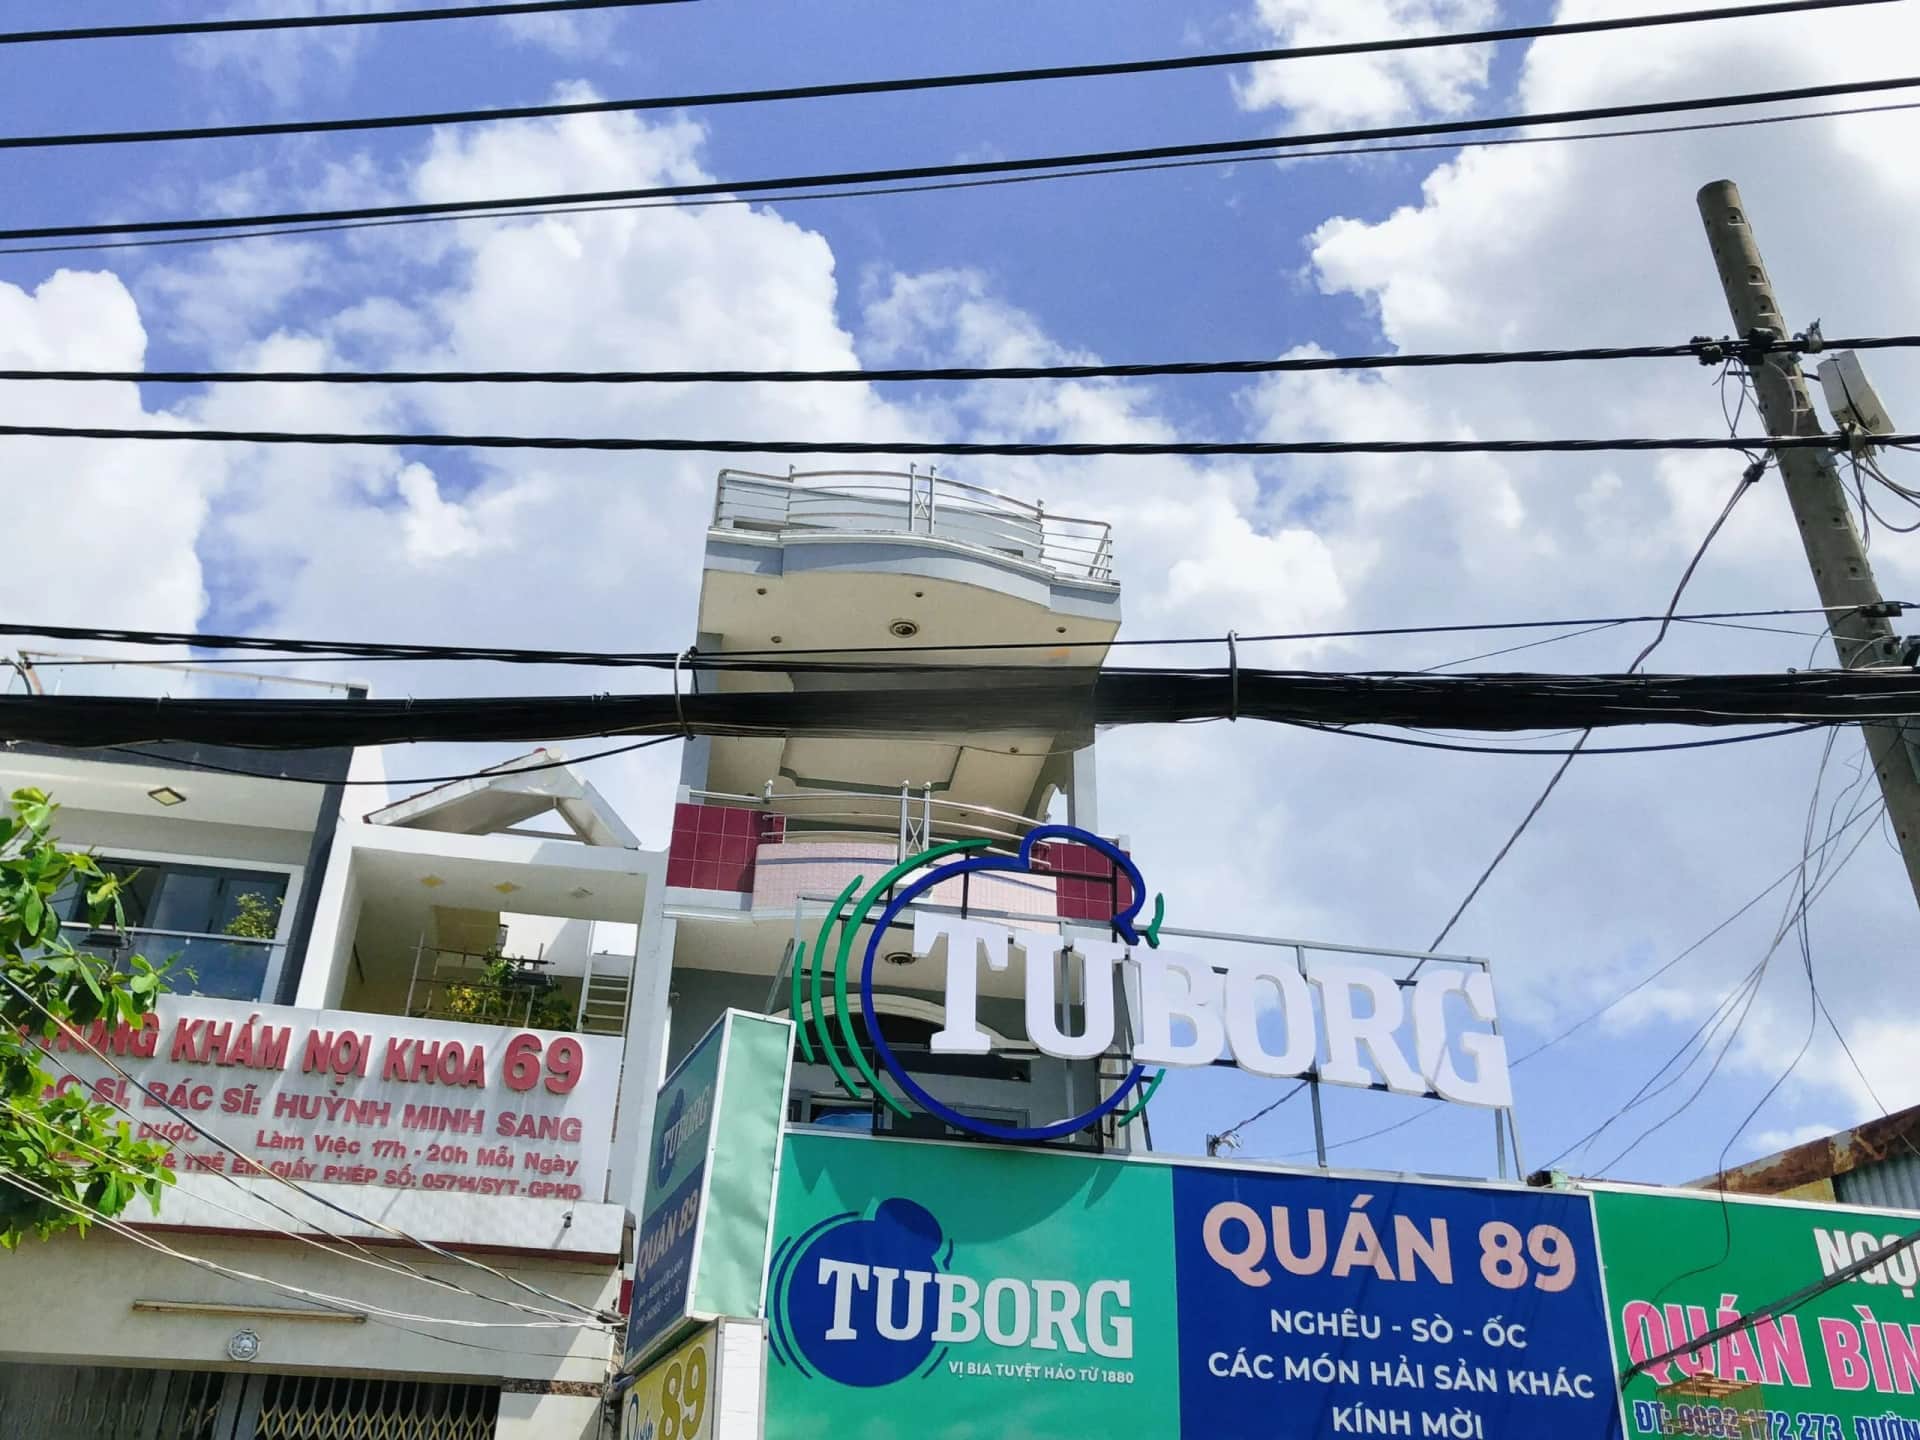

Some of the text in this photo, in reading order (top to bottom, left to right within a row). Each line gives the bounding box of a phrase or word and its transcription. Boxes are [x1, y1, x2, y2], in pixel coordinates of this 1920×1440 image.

[913, 910, 1513, 1108] TUBORG
[171, 1014, 291, 1070] KHÁM
[383, 1037, 485, 1088] KHOA
[503, 1033, 583, 1094] 69
[144, 1078, 213, 1111] BÁC
[274, 1090, 391, 1126] HUỲNH
[402, 1104, 485, 1134] MINH
[496, 1112, 582, 1142] SANG
[162, 1152, 177, 1169] &
[324, 1163, 377, 1184] PHÉP
[256, 1130, 304, 1150] Làm
[314, 1134, 360, 1158] Việc
[372, 1140, 406, 1159] 17h
[426, 1144, 468, 1164] 20h
[525, 1152, 578, 1177] Ngày
[638, 1211, 678, 1283] QUÁN
[679, 1189, 699, 1238] 89
[1202, 1194, 1577, 1292] QUÁN 89
[1813, 1228, 1920, 1298] NGỌ
[818, 1257, 1134, 1359] TUBORG
[1271, 1308, 1381, 1339] NGHÊU
[1412, 1313, 1454, 1344] SÒ
[1482, 1314, 1528, 1349] ỐC
[1622, 1293, 1812, 1387] QUÁN
[658, 1345, 708, 1440] 89
[949, 1361, 1134, 1383] VỊ BIA TUYỆT HẢO TỪ 1880
[1208, 1346, 1594, 1399] CÁC MÓN HẢI SẢN KHÁC
[1333, 1401, 1483, 1439] KÍNH MỜI
